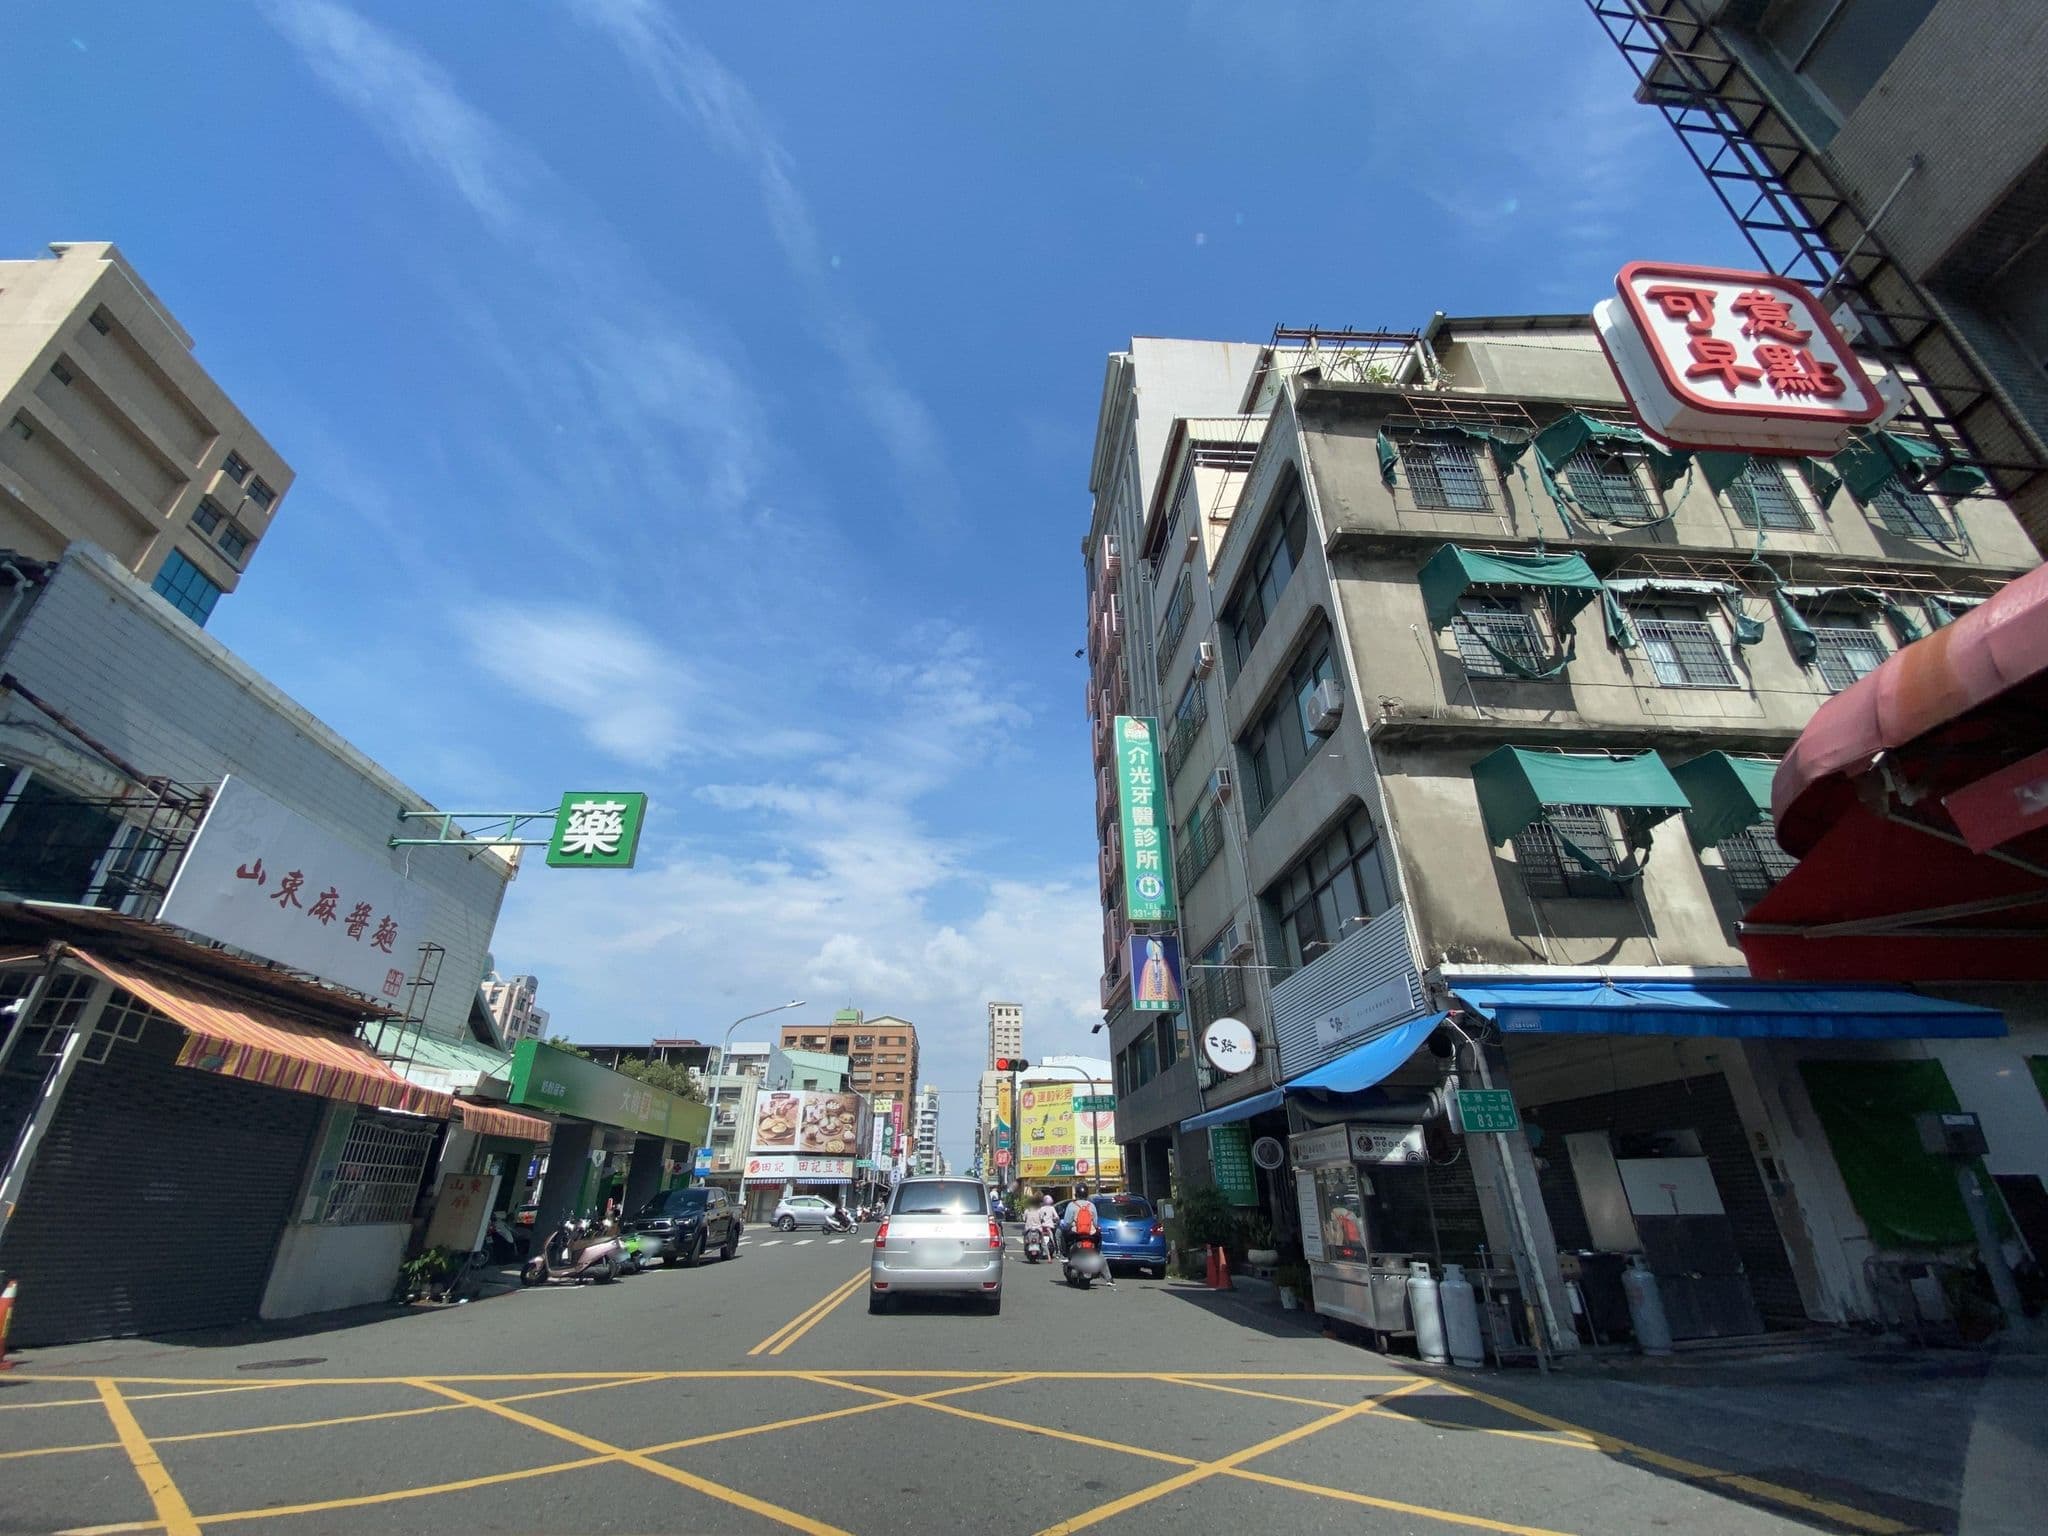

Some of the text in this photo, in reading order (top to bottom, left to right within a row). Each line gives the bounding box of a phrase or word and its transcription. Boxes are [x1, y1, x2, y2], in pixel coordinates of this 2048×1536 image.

[1645, 287, 1812, 346] 可意
[1685, 336, 1846, 398] 早點
[559, 800, 627, 856] 藥
[1127, 746, 1159, 870] 介光牙醫診所
[236, 857, 399, 954] 山東麻醬麵
[1477, 1113, 1494, 1127] 83
